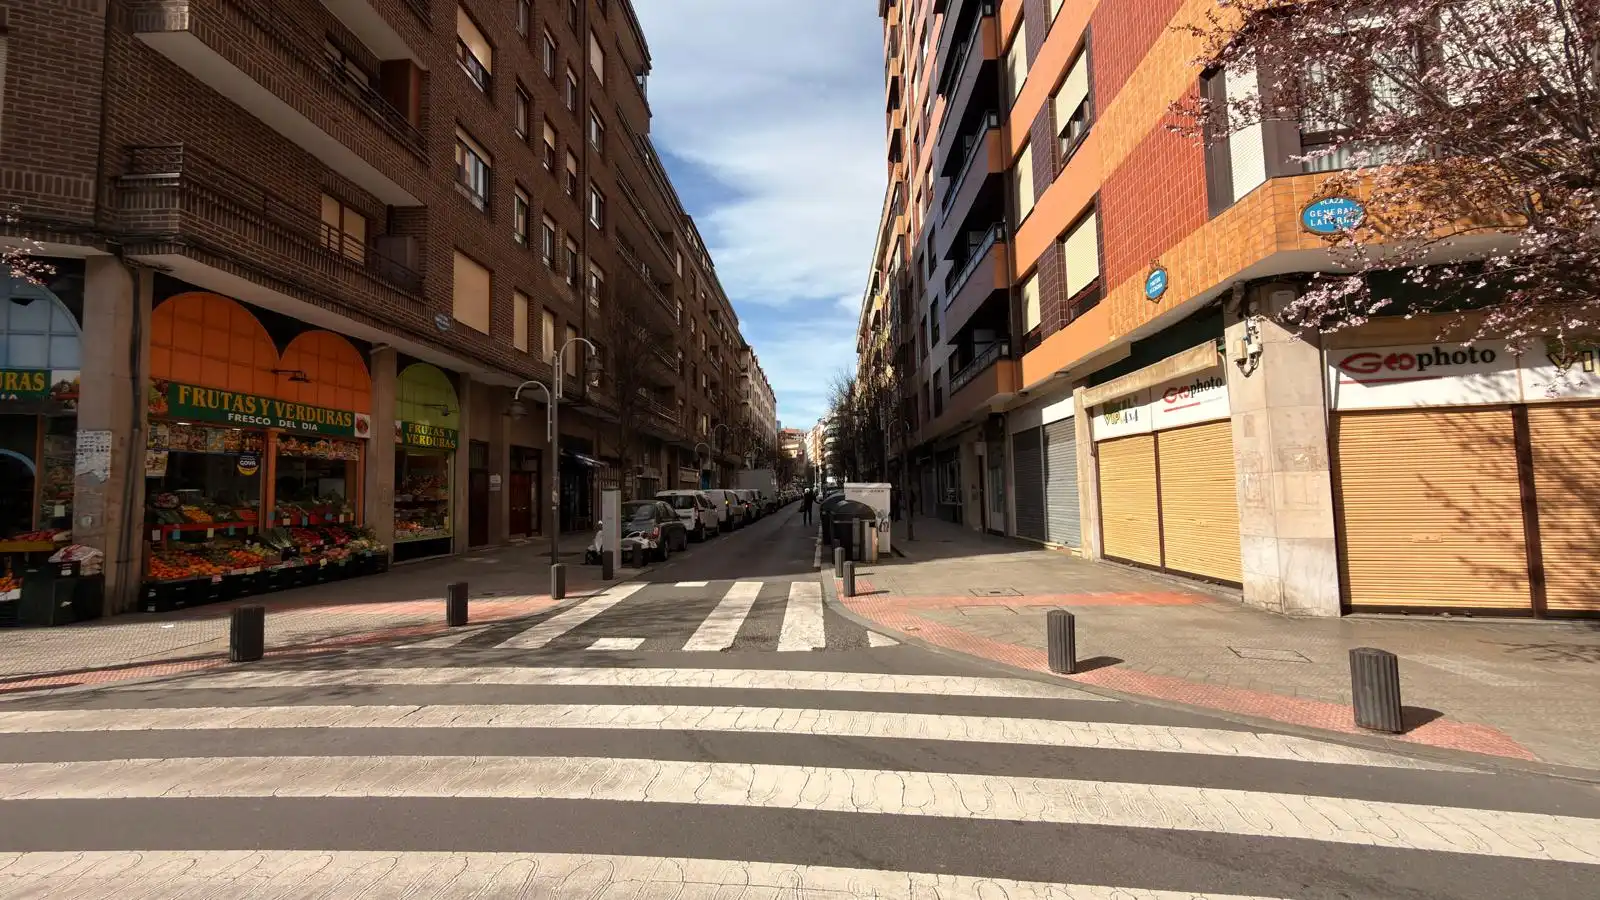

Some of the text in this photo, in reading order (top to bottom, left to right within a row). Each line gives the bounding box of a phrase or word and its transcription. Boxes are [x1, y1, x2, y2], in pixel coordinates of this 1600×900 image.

[1339, 346, 1496, 373] Geophoto
[1163, 376, 1223, 404] Geophoto
[178, 384, 353, 427] FRUTAS Y VERDURAS
[228, 413, 318, 431] FRESCO DEL DIA
[408, 423, 444, 437] FRUTAS
[406, 433, 456, 448] VERDURAS
